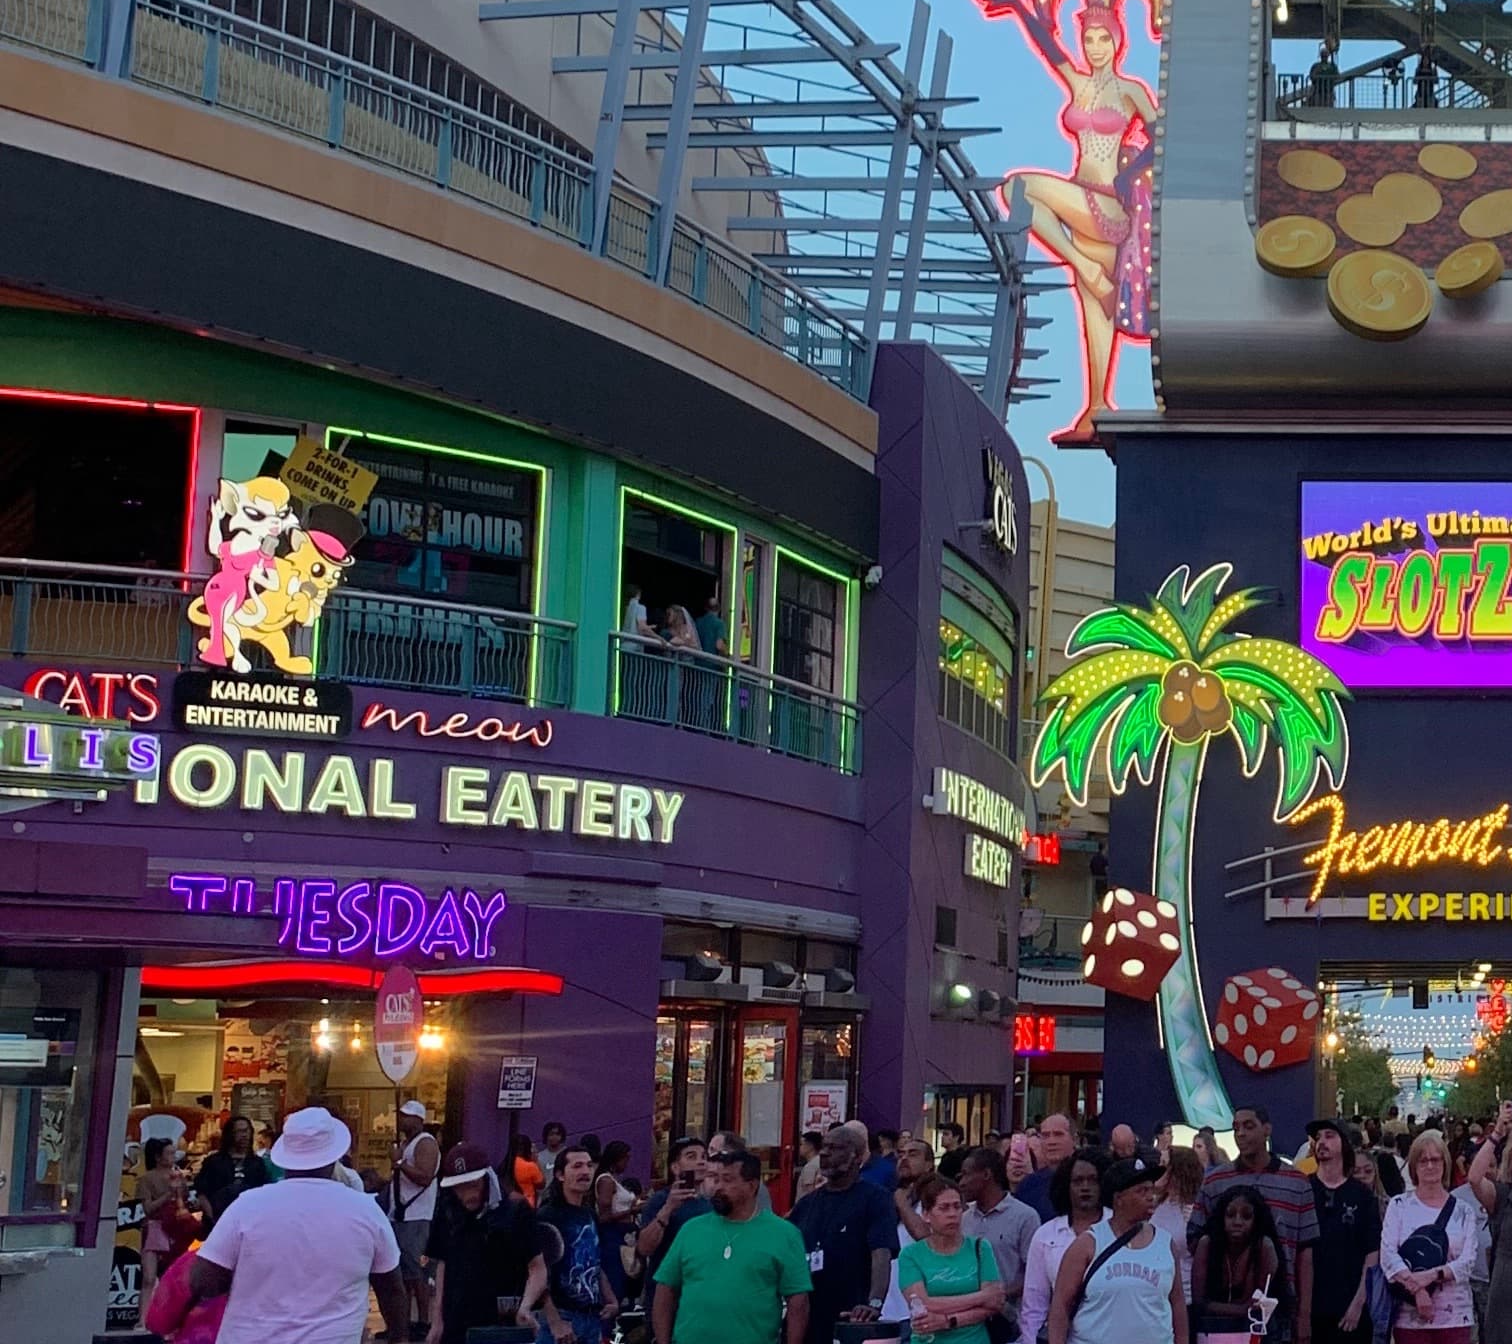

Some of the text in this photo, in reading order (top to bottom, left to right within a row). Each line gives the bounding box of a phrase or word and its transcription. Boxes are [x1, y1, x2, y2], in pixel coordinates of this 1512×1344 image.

[312, 447, 360, 479] 2-FOR-1
[286, 467, 357, 510] COME ON UP
[447, 475, 469, 491] FREE
[471, 480, 515, 500] KARAOKE
[443, 508, 524, 557] HOUR
[1301, 516, 1418, 562] World's
[23, 667, 161, 723] CAT'S
[210, 679, 319, 708] KARAOKE &
[185, 705, 341, 735] ENTERTAINMENT
[360, 701, 554, 748] meow
[22, 725, 161, 773] LIS
[439, 765, 686, 844] EATERY
[971, 833, 1013, 889] EATERY
[1290, 792, 1510, 910] Fremont
[169, 873, 506, 959] TUESDAY
[109, 1263, 142, 1292] AT
[1105, 1261, 1161, 1288] JORDAN
